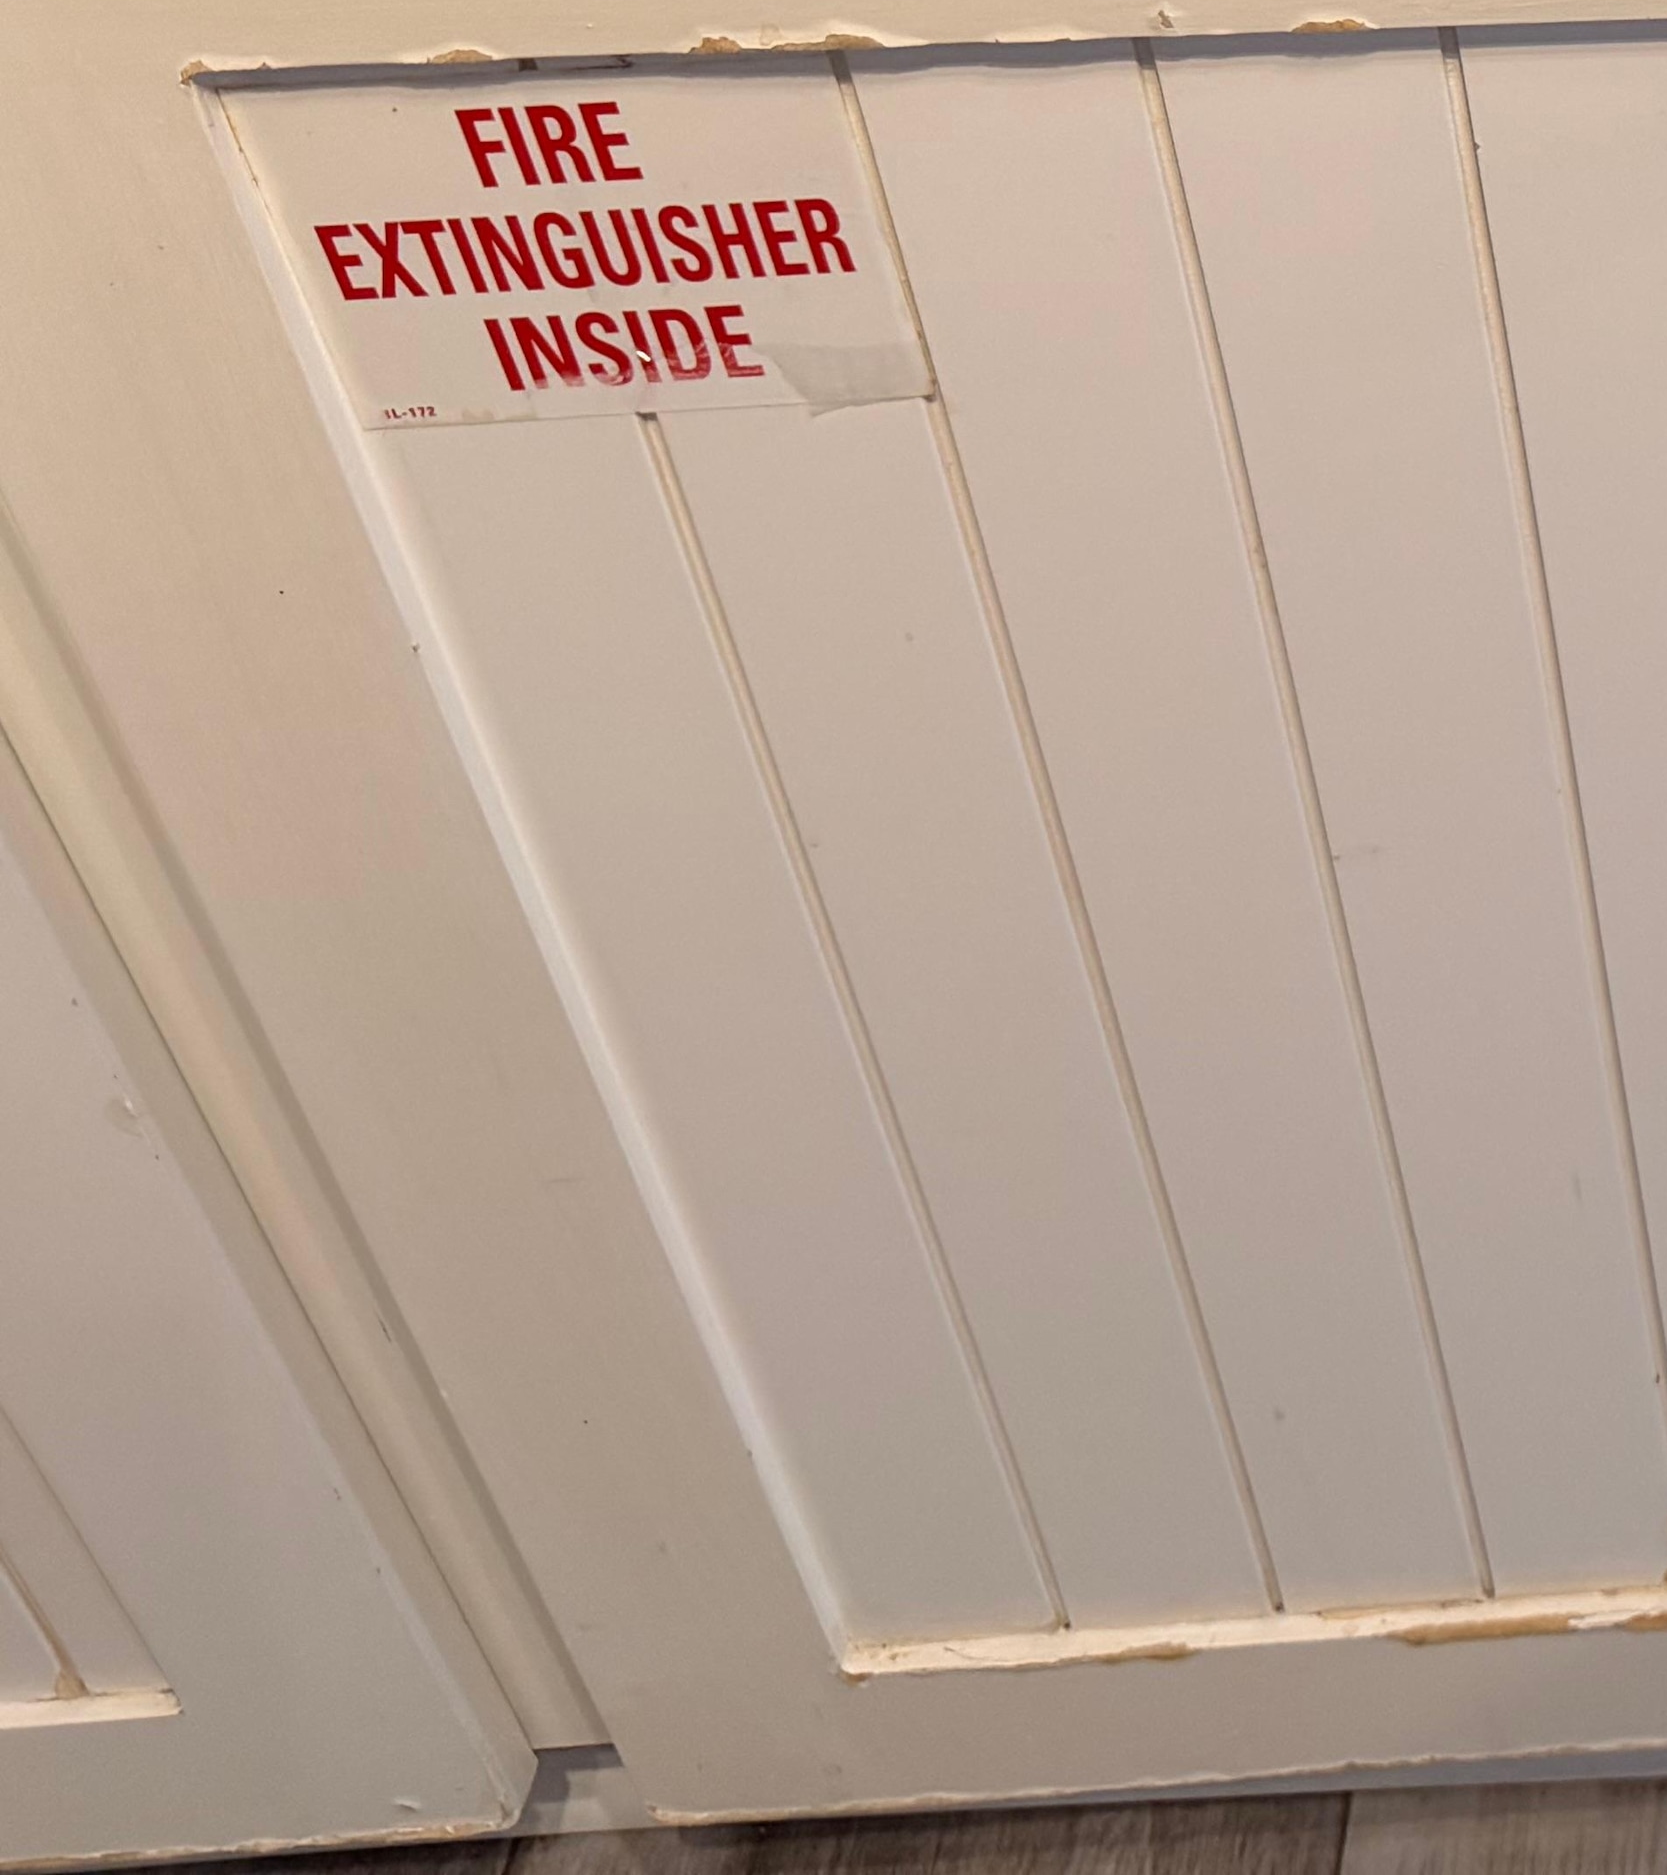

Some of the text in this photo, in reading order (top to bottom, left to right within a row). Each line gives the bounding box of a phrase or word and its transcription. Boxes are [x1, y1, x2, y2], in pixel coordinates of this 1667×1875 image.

[454, 101, 643, 188] FIRE
[313, 198, 855, 301] EXTINGUISHER
[483, 305, 764, 391] INSIDE
